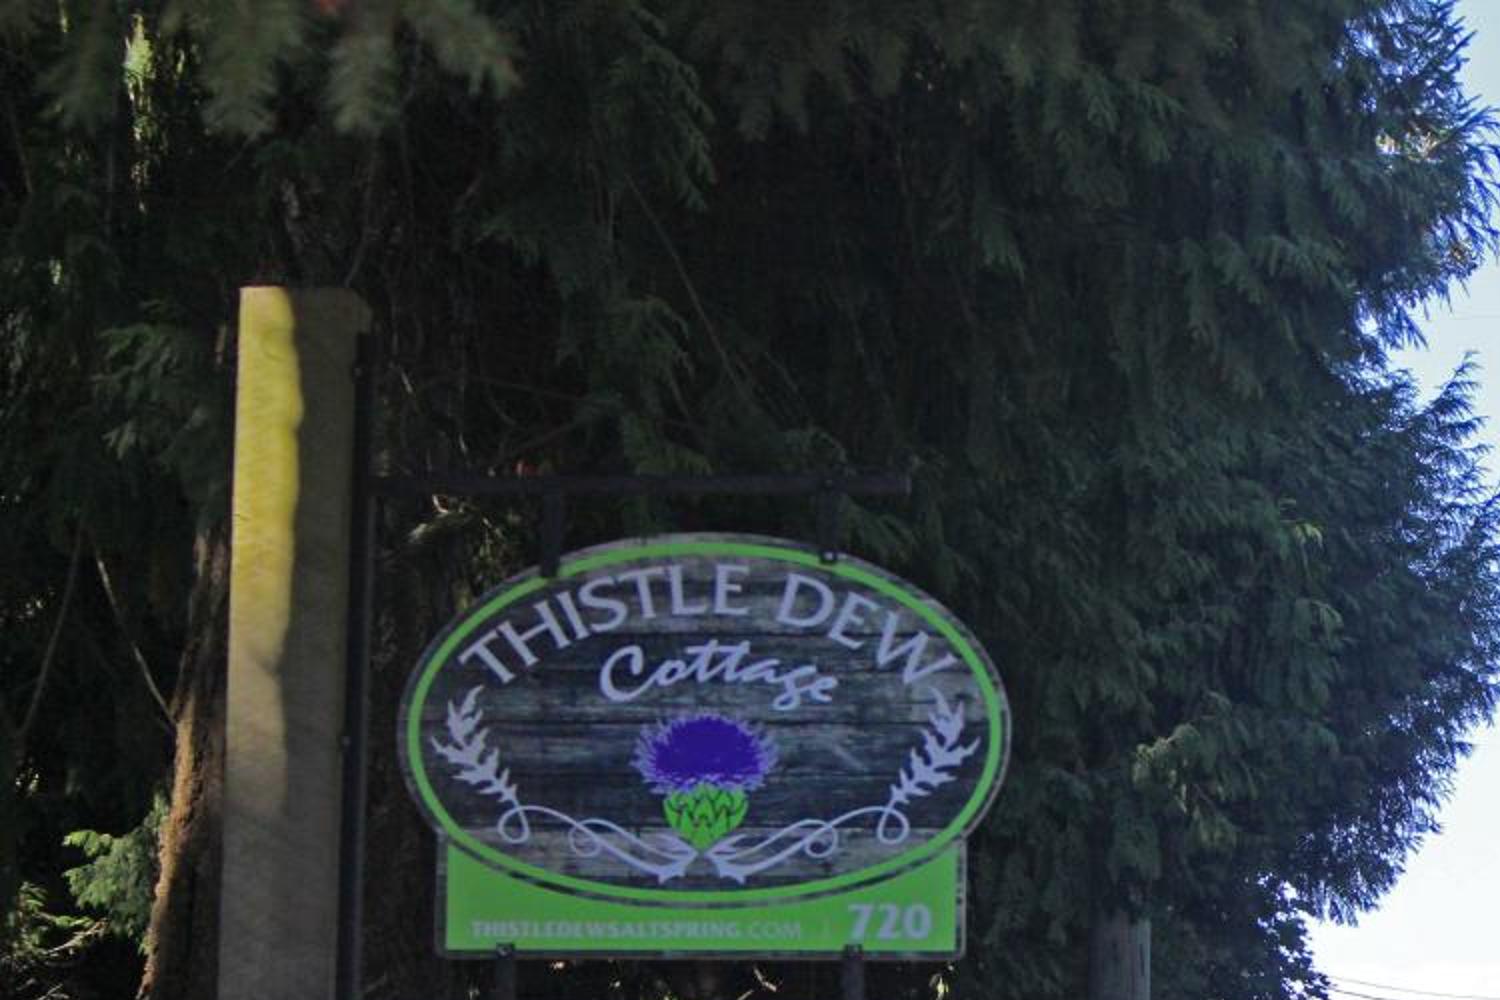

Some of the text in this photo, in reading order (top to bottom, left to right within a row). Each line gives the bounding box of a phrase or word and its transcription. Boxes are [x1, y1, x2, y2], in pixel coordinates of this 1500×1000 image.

[458, 563, 963, 686] THISTLE DEW
[599, 640, 839, 711] Cottage
[847, 902, 932, 941] 720
